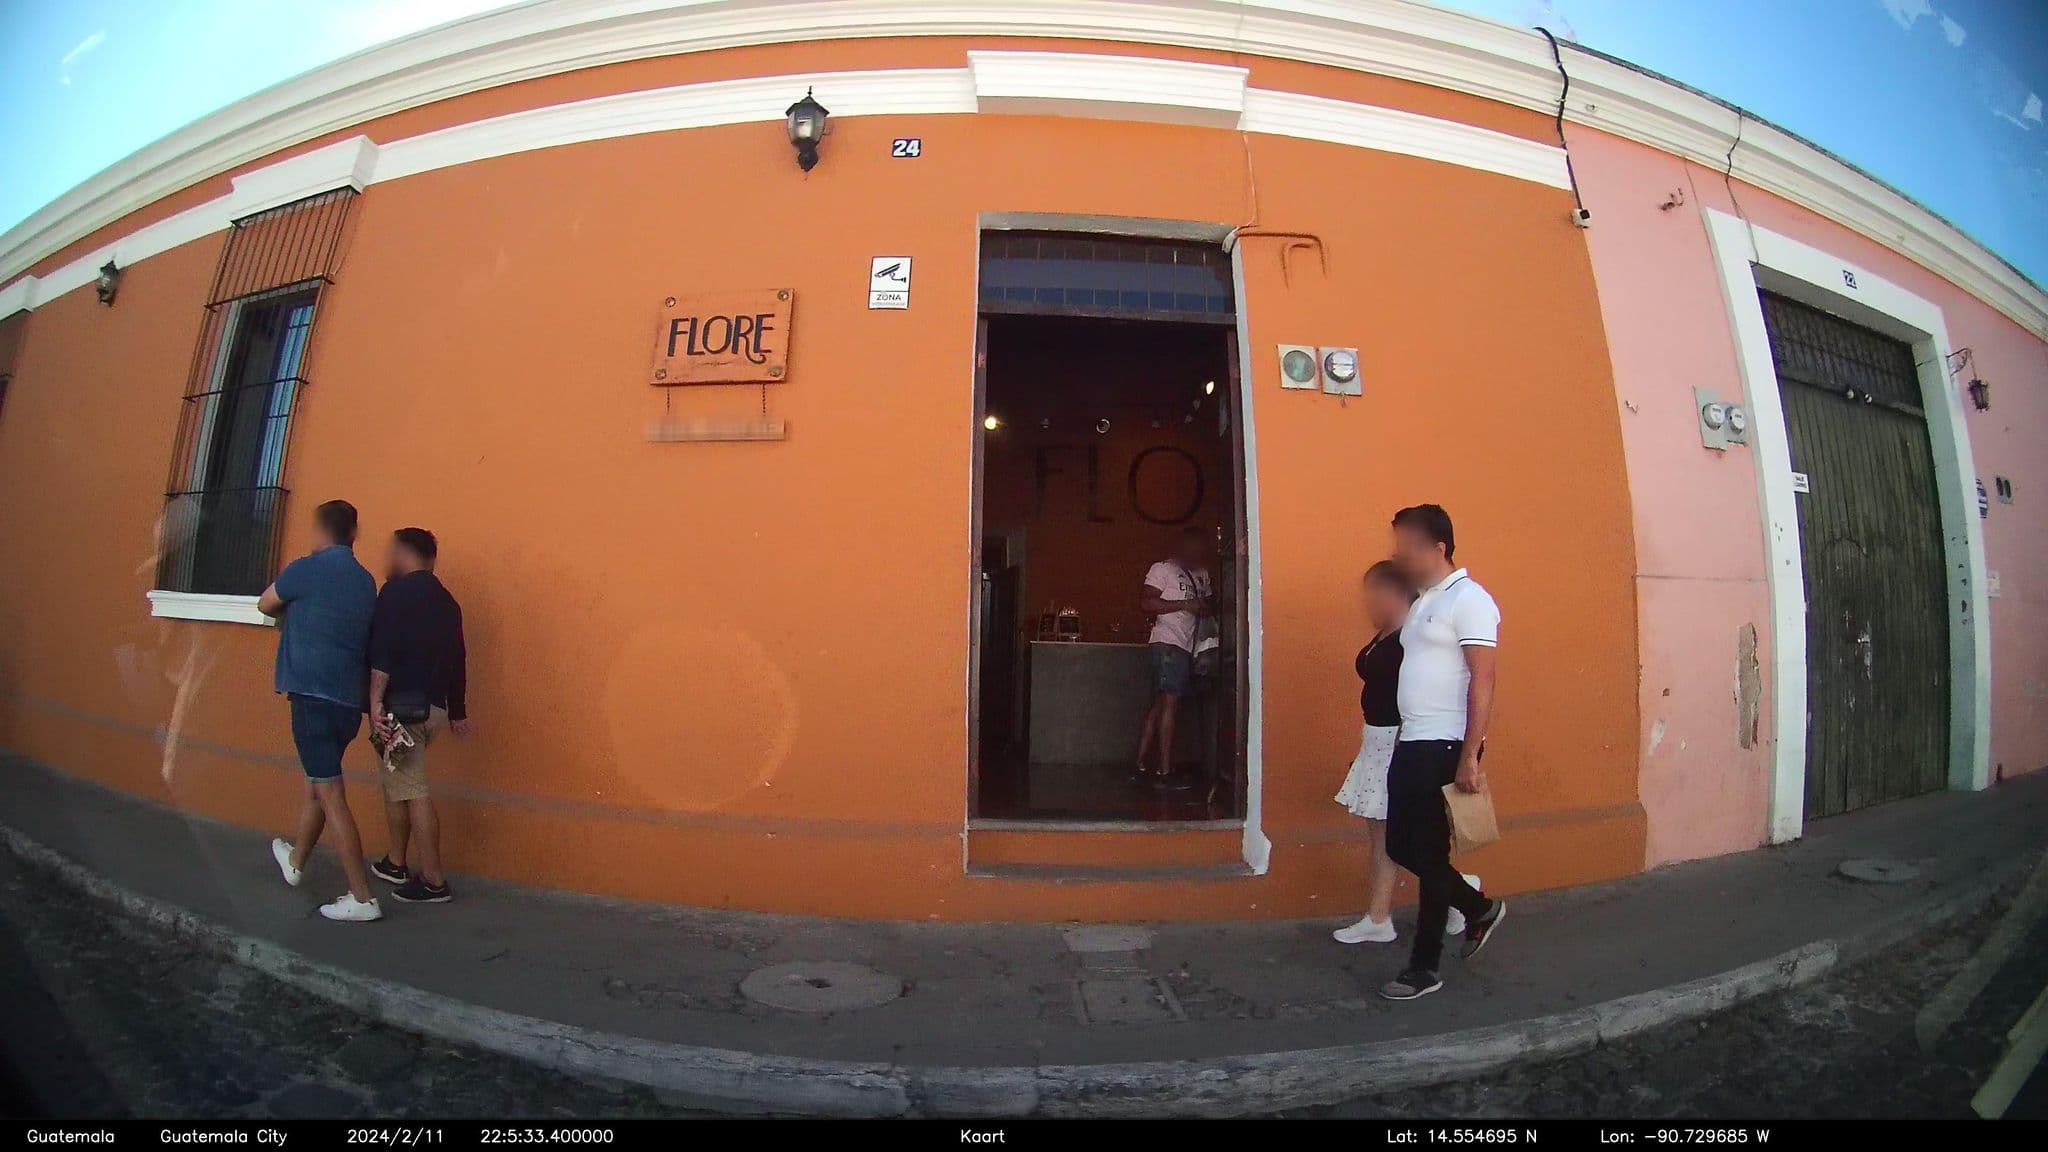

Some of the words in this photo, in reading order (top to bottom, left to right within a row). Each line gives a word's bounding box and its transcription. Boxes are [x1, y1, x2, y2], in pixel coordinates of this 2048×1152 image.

[893, 140, 920, 157] 24
[876, 293, 902, 301] ZONA
[666, 314, 776, 364] FLORE
